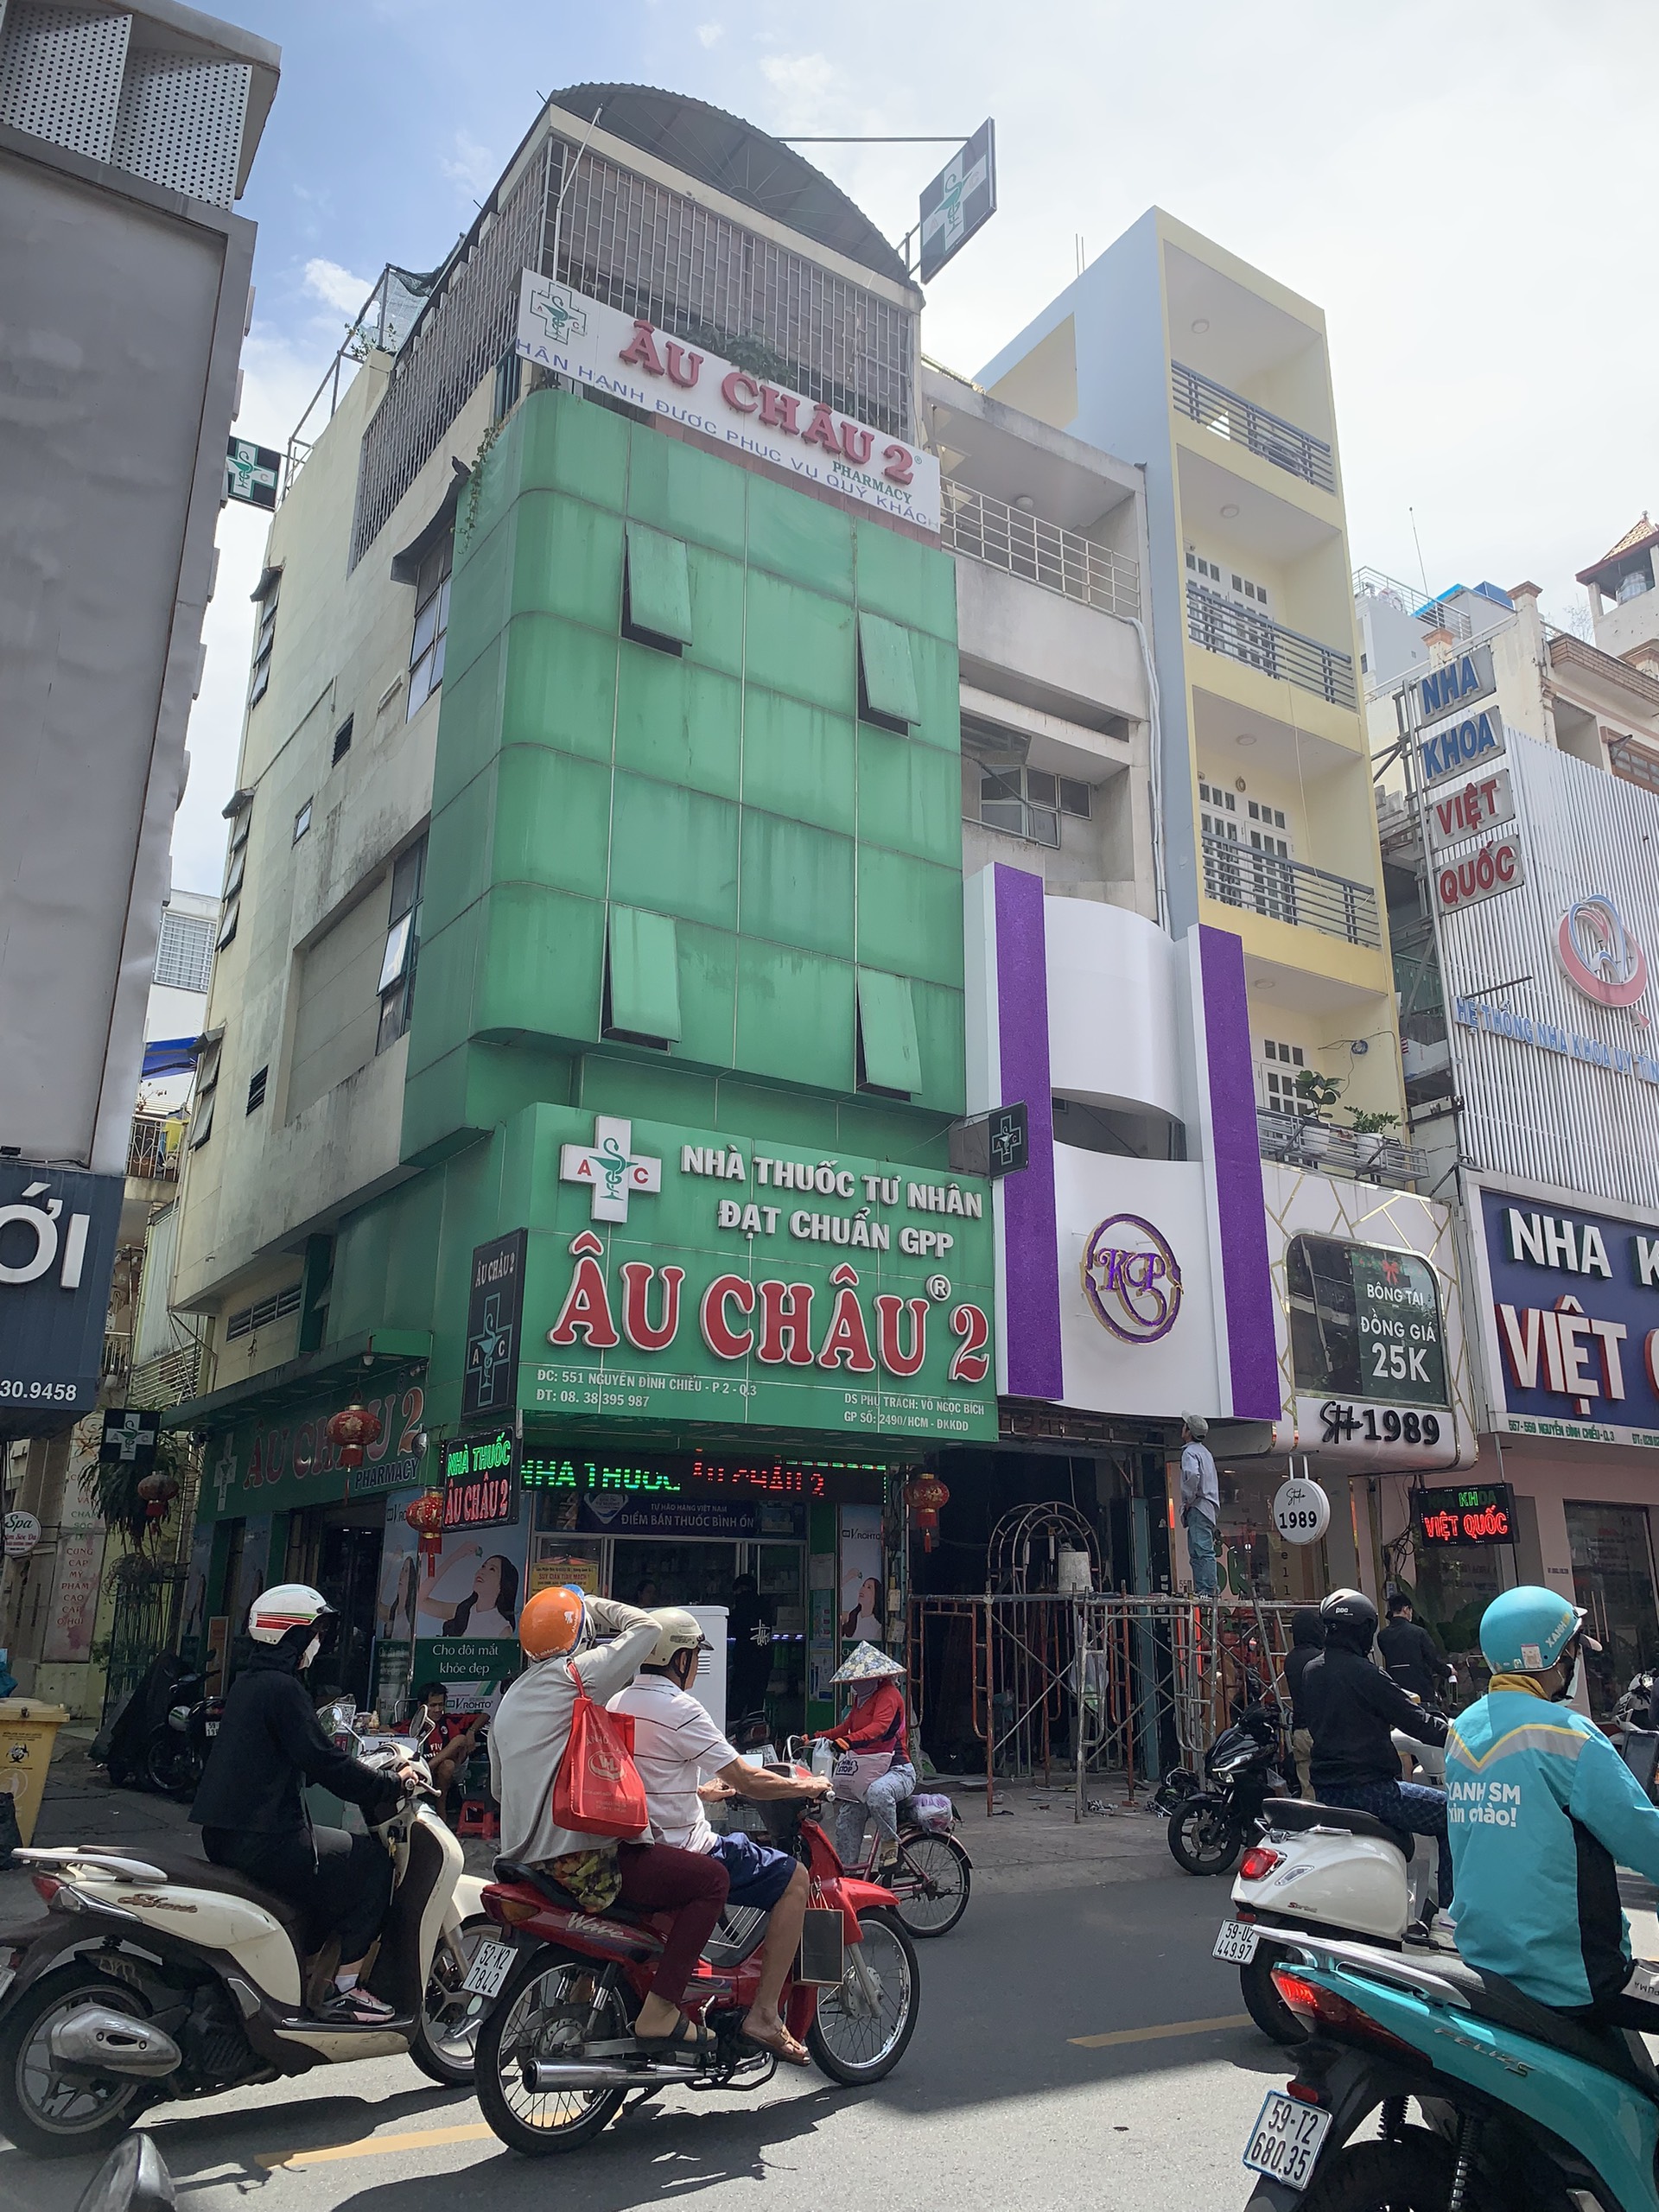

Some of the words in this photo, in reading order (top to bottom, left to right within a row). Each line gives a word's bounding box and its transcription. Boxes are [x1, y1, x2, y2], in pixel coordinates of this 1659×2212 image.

[619, 319, 704, 388] ÂU
[721, 371, 875, 465] CHÂU
[883, 443, 915, 486] 2
[516, 338, 569, 371] HÂN
[578, 365, 645, 404] HẠNH
[726, 429, 781, 463] PHỤC
[791, 456, 818, 480] VỤ
[826, 474, 868, 499] QUÝ
[876, 494, 940, 530] KHÁCH
[832, 460, 912, 505] PHARMACY
[1421, 655, 1479, 716] NHA
[1422, 712, 1497, 779] KHOA
[1435, 779, 1498, 836] VIỆT
[1440, 841, 1516, 906] QUỐC
[1479, 998, 1534, 1045] THỐNG
[1535, 1020, 1568, 1056] NHA
[1570, 1032, 1612, 1070] KHOA
[1613, 1046, 1632, 1077] UY
[576, 1158, 592, 1177] A
[633, 1168, 649, 1185] C
[681, 1143, 746, 1182] NHÀ
[753, 1155, 855, 1199] THUỐC
[861, 1173, 902, 1206] TƯ
[906, 1180, 983, 1219] NHÂN
[717, 1198, 781, 1241] ĐẠT
[788, 1206, 890, 1251] CHUẨN
[898, 1226, 954, 1259] GPP
[1503, 1207, 1613, 1279] NHA
[487, 1250, 510, 1284] CHÂU
[546, 1228, 686, 1352] ÂU
[700, 1262, 932, 1378] CHÂU
[947, 1302, 991, 1383] 2
[1366, 1282, 1403, 1303] BÔNG
[1360, 1306, 1405, 1338] ĐỒNG
[1408, 1320, 1437, 1344] GIÁ
[498, 1339, 505, 1357] C
[1370, 1342, 1431, 1383] 25K
[1495, 1294, 1627, 1415] VIỆT
[537, 1369, 558, 1382] ĐC:
[562, 1370, 583, 1384] 551
[639, 1375, 666, 1389] ĐÌNH
[536, 1389, 556, 1402] ĐT:
[561, 1391, 579, 1403] 08.
[583, 1393, 599, 1405] 38
[602, 1394, 625, 1406] 395
[627, 1395, 650, 1408] 987
[843, 1411, 857, 1422] GP
[860, 1408, 877, 1424] SỐ:
[844, 1393, 858, 1405] DS
[883, 1394, 918, 1410] TRÁCH:
[936, 1401, 961, 1415] NGỌC
[963, 1401, 985, 1415] BÍCH
[242, 1417, 290, 1491] ÂU
[292, 1386, 397, 1480] CHU
[397, 1386, 425, 1457] 2
[1363, 1408, 1440, 1446] 1989
[447, 1442, 470, 1478] NHÀ
[472, 1431, 512, 1472] THUỐC
[354, 1458, 421, 1491] PHARMACY
[444, 1478, 463, 1525] ÂU
[464, 1470, 499, 1521] CHÂU
[499, 1478, 509, 1517] 2
[5, 1514, 33, 1533] Spa
[620, 1510, 648, 1526] ĐIỂM
[651, 1511, 672, 1527] BÁN
[674, 1512, 711, 1528] THUỐC
[712, 1514, 737, 1528] BÌNH
[1279, 1510, 1318, 1529] 1989
[1423, 1510, 1459, 1542] VIỆT
[1463, 1504, 1509, 1541] QUỐC
[432, 1643, 456, 1656] Cho
[457, 1643, 475, 1656] đôi
[478, 1642, 499, 1656] mắt
[439, 1661, 466, 1675] khỏe
[468, 1661, 491, 1678] đẹp
[1488, 1782, 1521, 1805] SM
[1217, 1941, 1253, 1961] 449.97
[467, 1967, 500, 1993] 7842
[1268, 2098, 1319, 2145] 59-T2
[1250, 2131, 1313, 2181] 680.35
